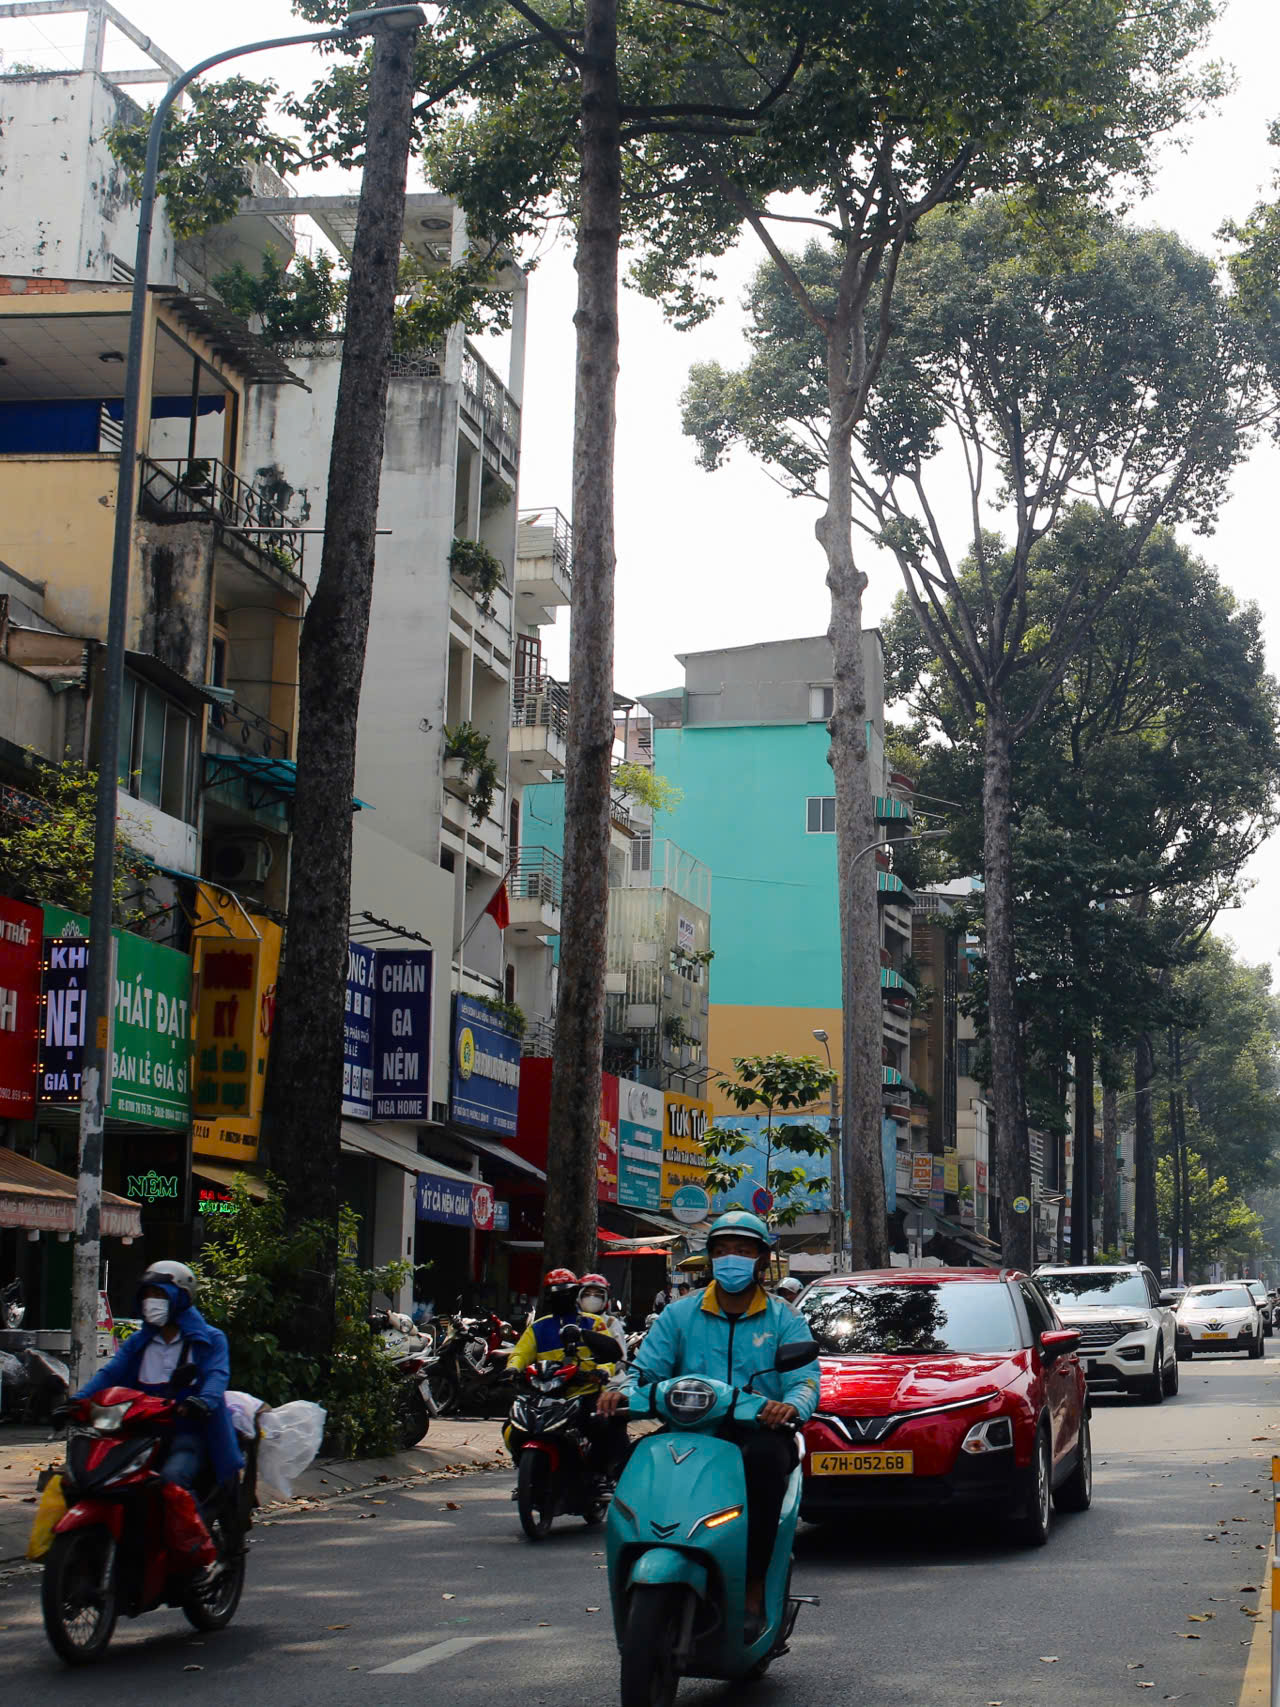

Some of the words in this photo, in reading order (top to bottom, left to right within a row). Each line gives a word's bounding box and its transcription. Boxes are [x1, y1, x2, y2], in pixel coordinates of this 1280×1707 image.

[51, 946, 89, 969] KH
[382, 959, 426, 993] CHĂN
[156, 992, 188, 1049] ĐẠT
[391, 1008, 414, 1037] GA
[44, 1069, 69, 1091] GIÁ
[112, 1047, 136, 1082] BÁN
[153, 1058, 175, 1091] GIÁ
[382, 1046, 419, 1087] NỆM
[377, 1100, 396, 1115] NGA
[397, 1101, 423, 1115] HOME
[669, 1103, 690, 1137] Tuk
[127, 1170, 178, 1203] NỆM
[820, 1456, 904, 1471] 47H-052.68
